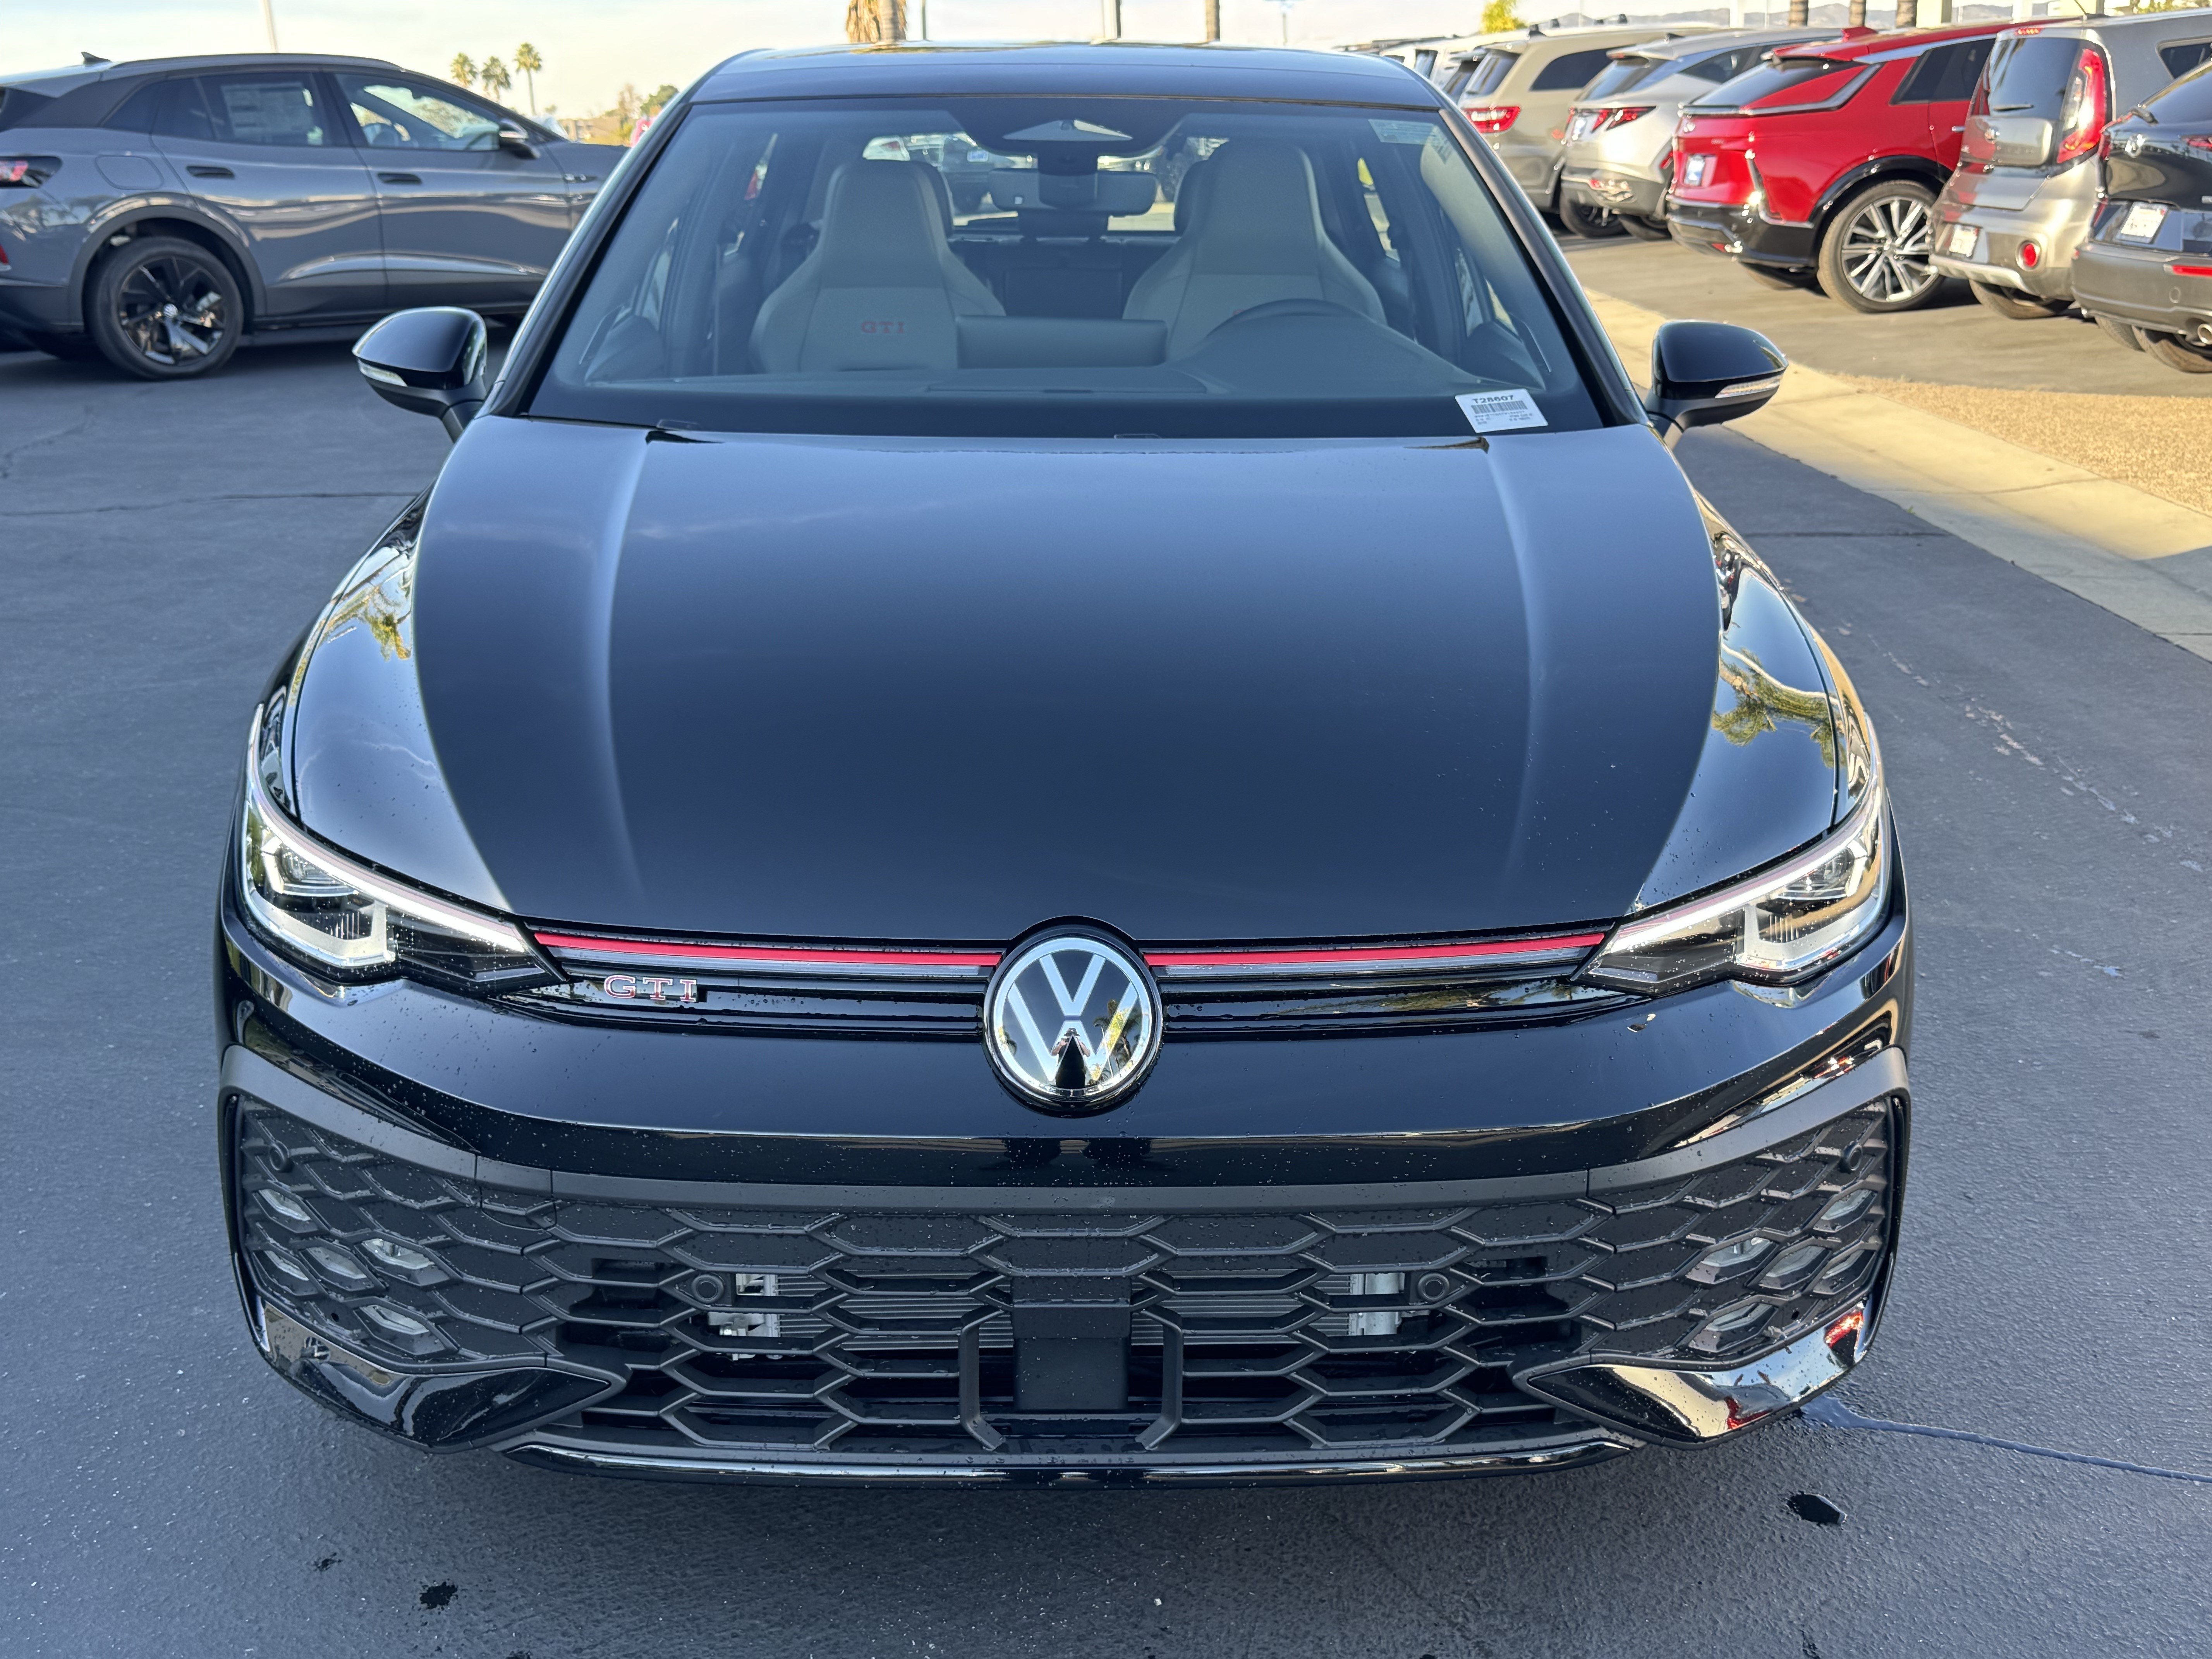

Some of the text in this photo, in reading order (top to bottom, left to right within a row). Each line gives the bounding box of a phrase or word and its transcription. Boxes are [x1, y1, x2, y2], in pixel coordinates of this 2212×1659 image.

[861, 321, 905, 333] GTI
[1472, 395, 1514, 404] T28607
[604, 975, 697, 1002] GTI
